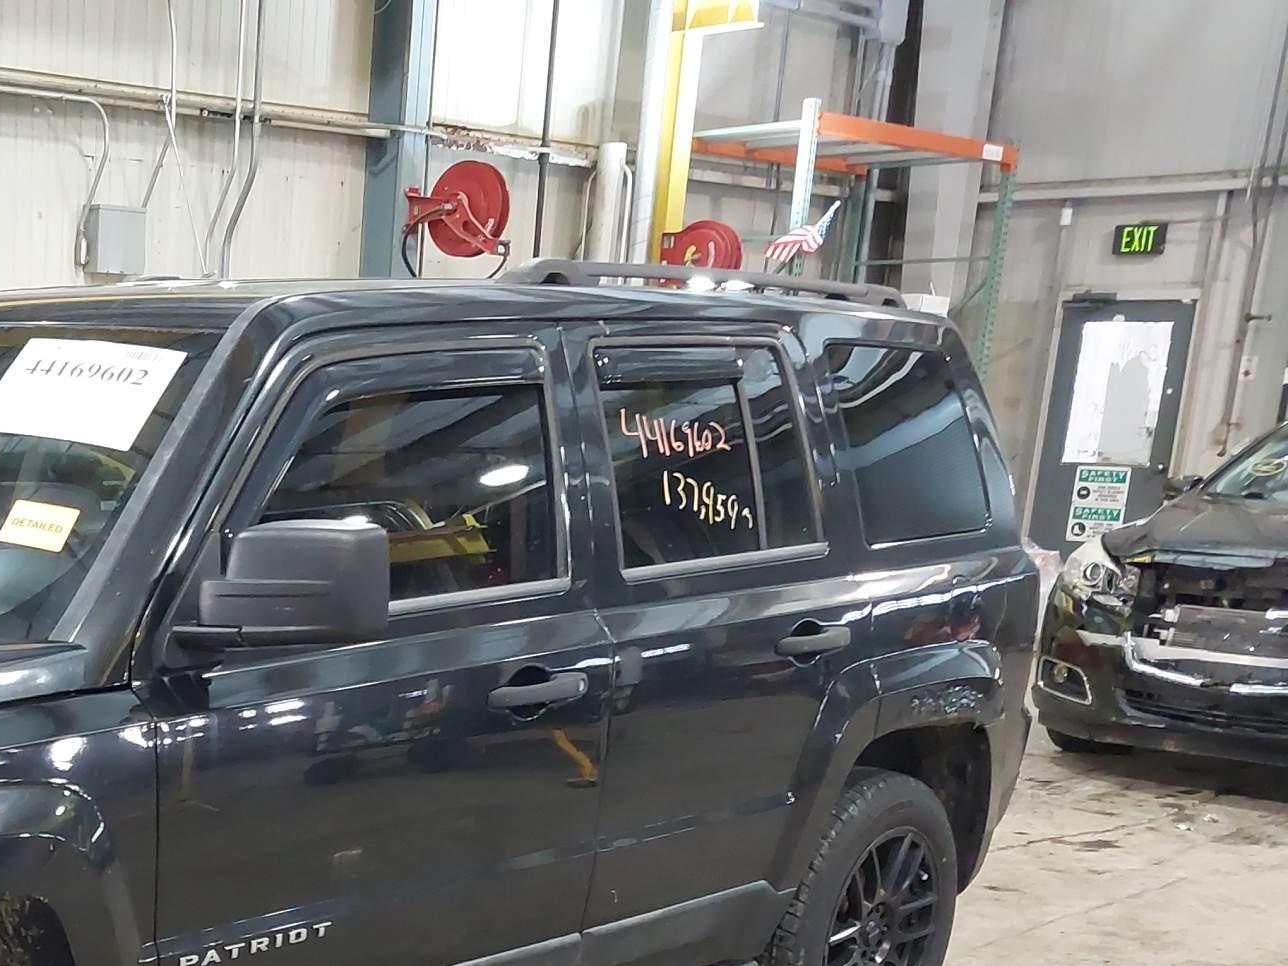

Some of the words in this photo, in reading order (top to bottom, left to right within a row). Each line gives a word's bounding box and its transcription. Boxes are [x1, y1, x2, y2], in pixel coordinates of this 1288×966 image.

[1120, 225, 1160, 252] EXIT
[25, 359, 149, 386] 44169602
[1081, 470, 1125, 479] SAFETY
[1074, 507, 1120, 517] SAFETY
[12, 517, 63, 533] DETAILED
